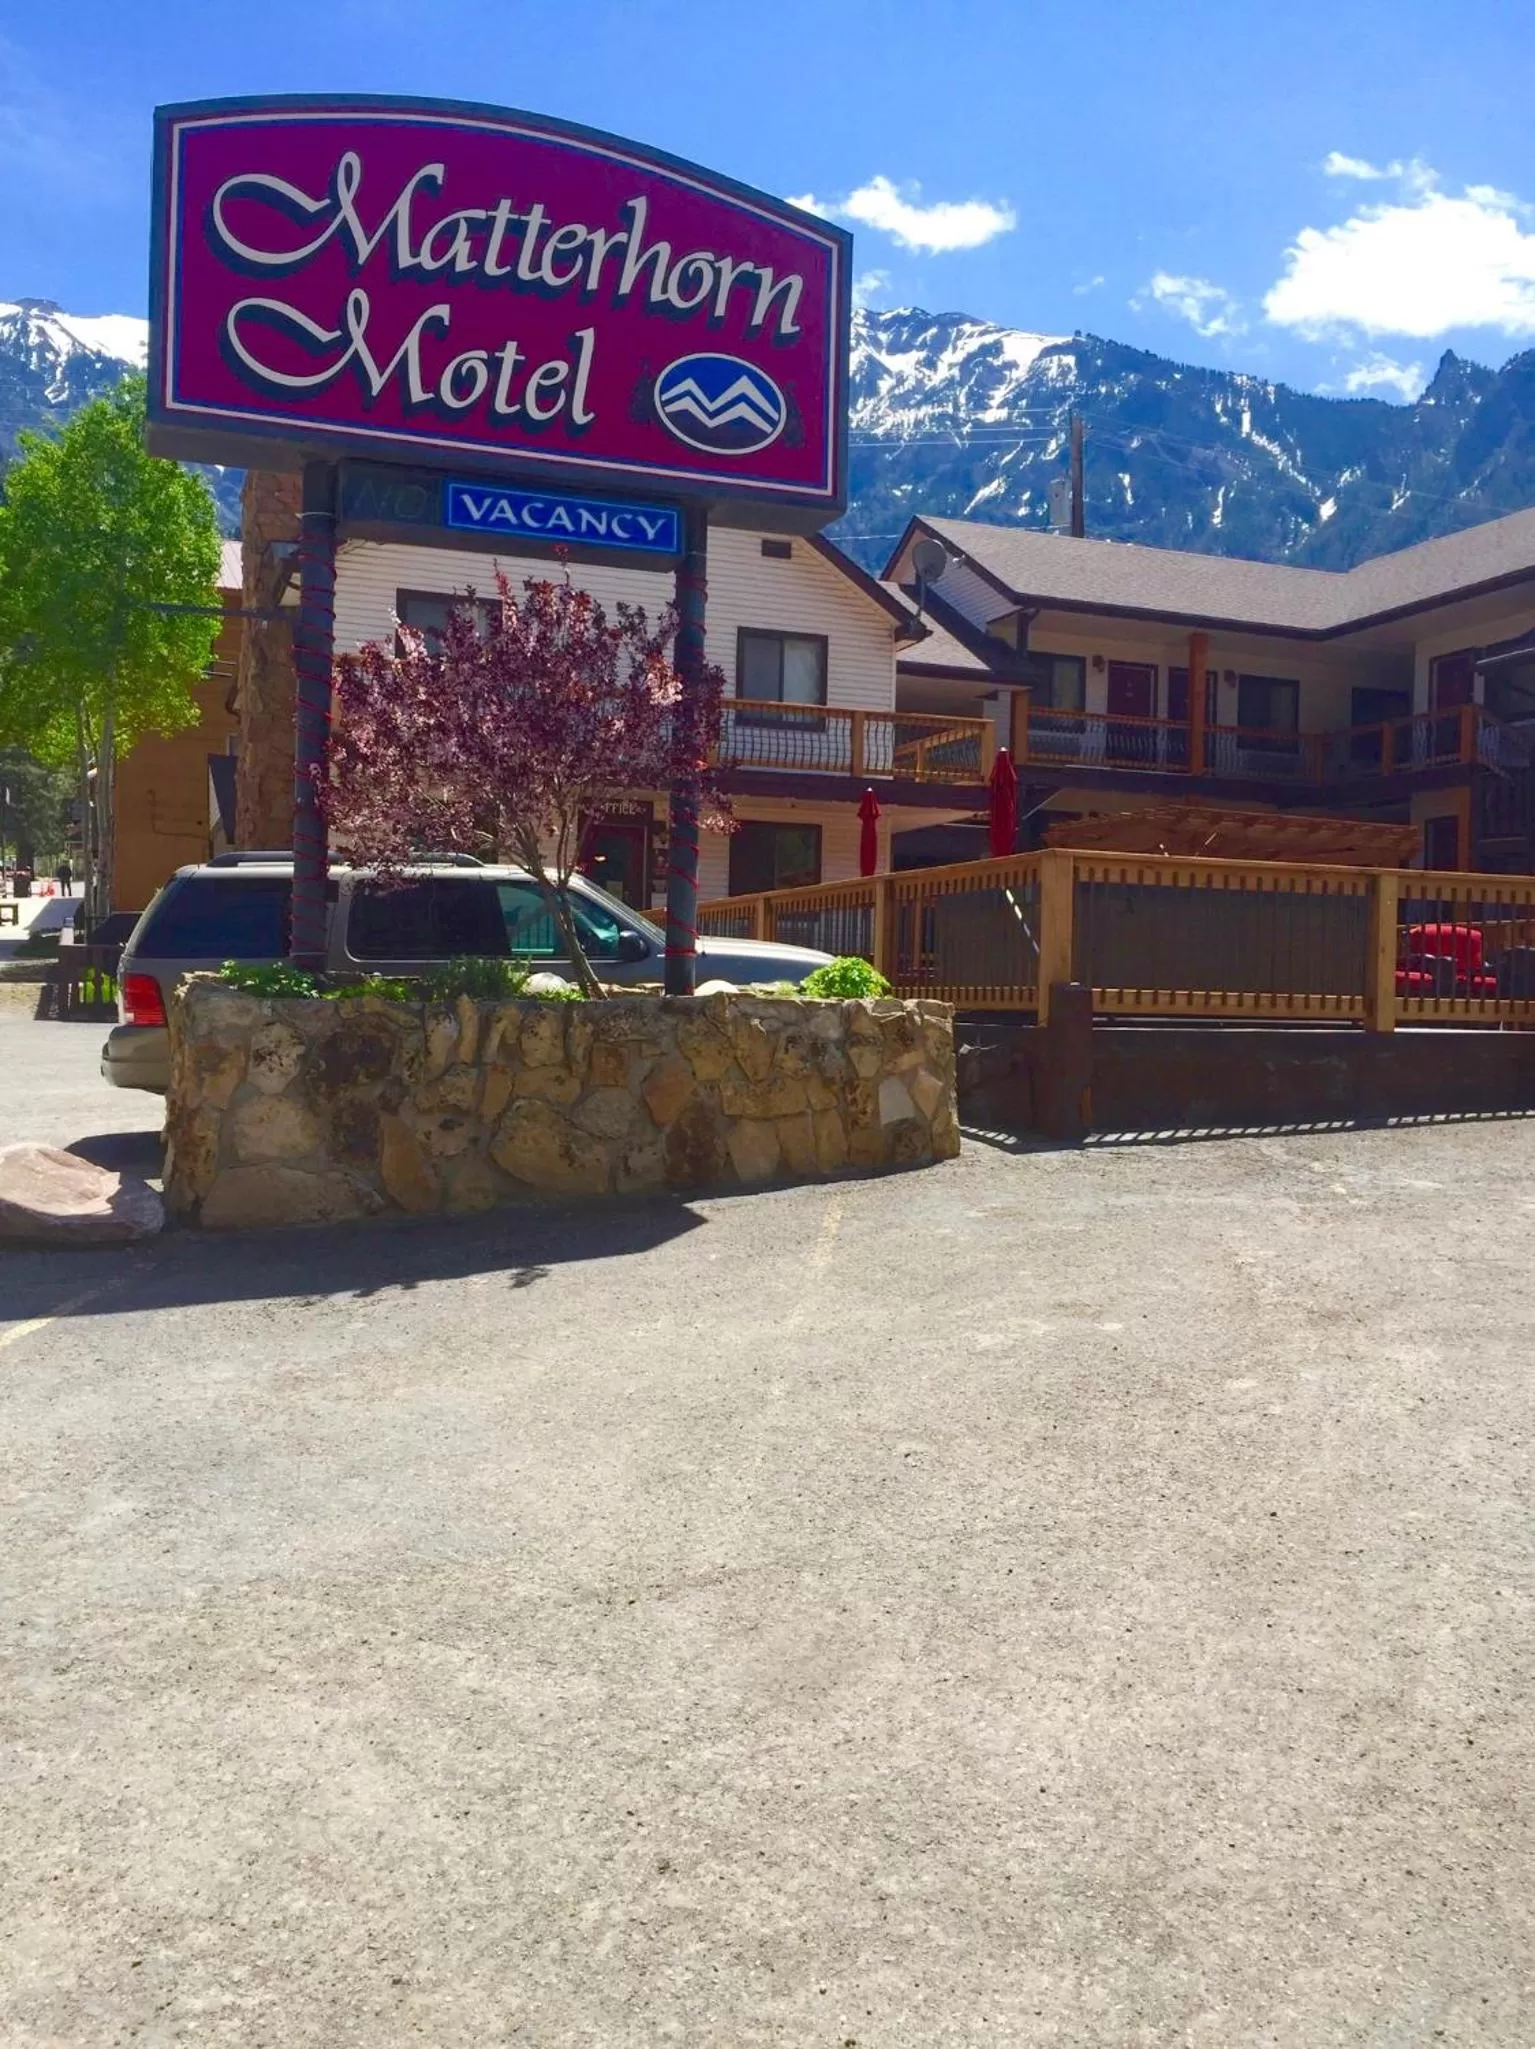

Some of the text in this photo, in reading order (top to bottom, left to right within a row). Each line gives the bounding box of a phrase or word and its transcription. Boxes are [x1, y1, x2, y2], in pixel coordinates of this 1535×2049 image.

[211, 150, 804, 336] Matterhorn
[225, 287, 596, 427] Motel
[460, 493, 668, 541] VACANCY
